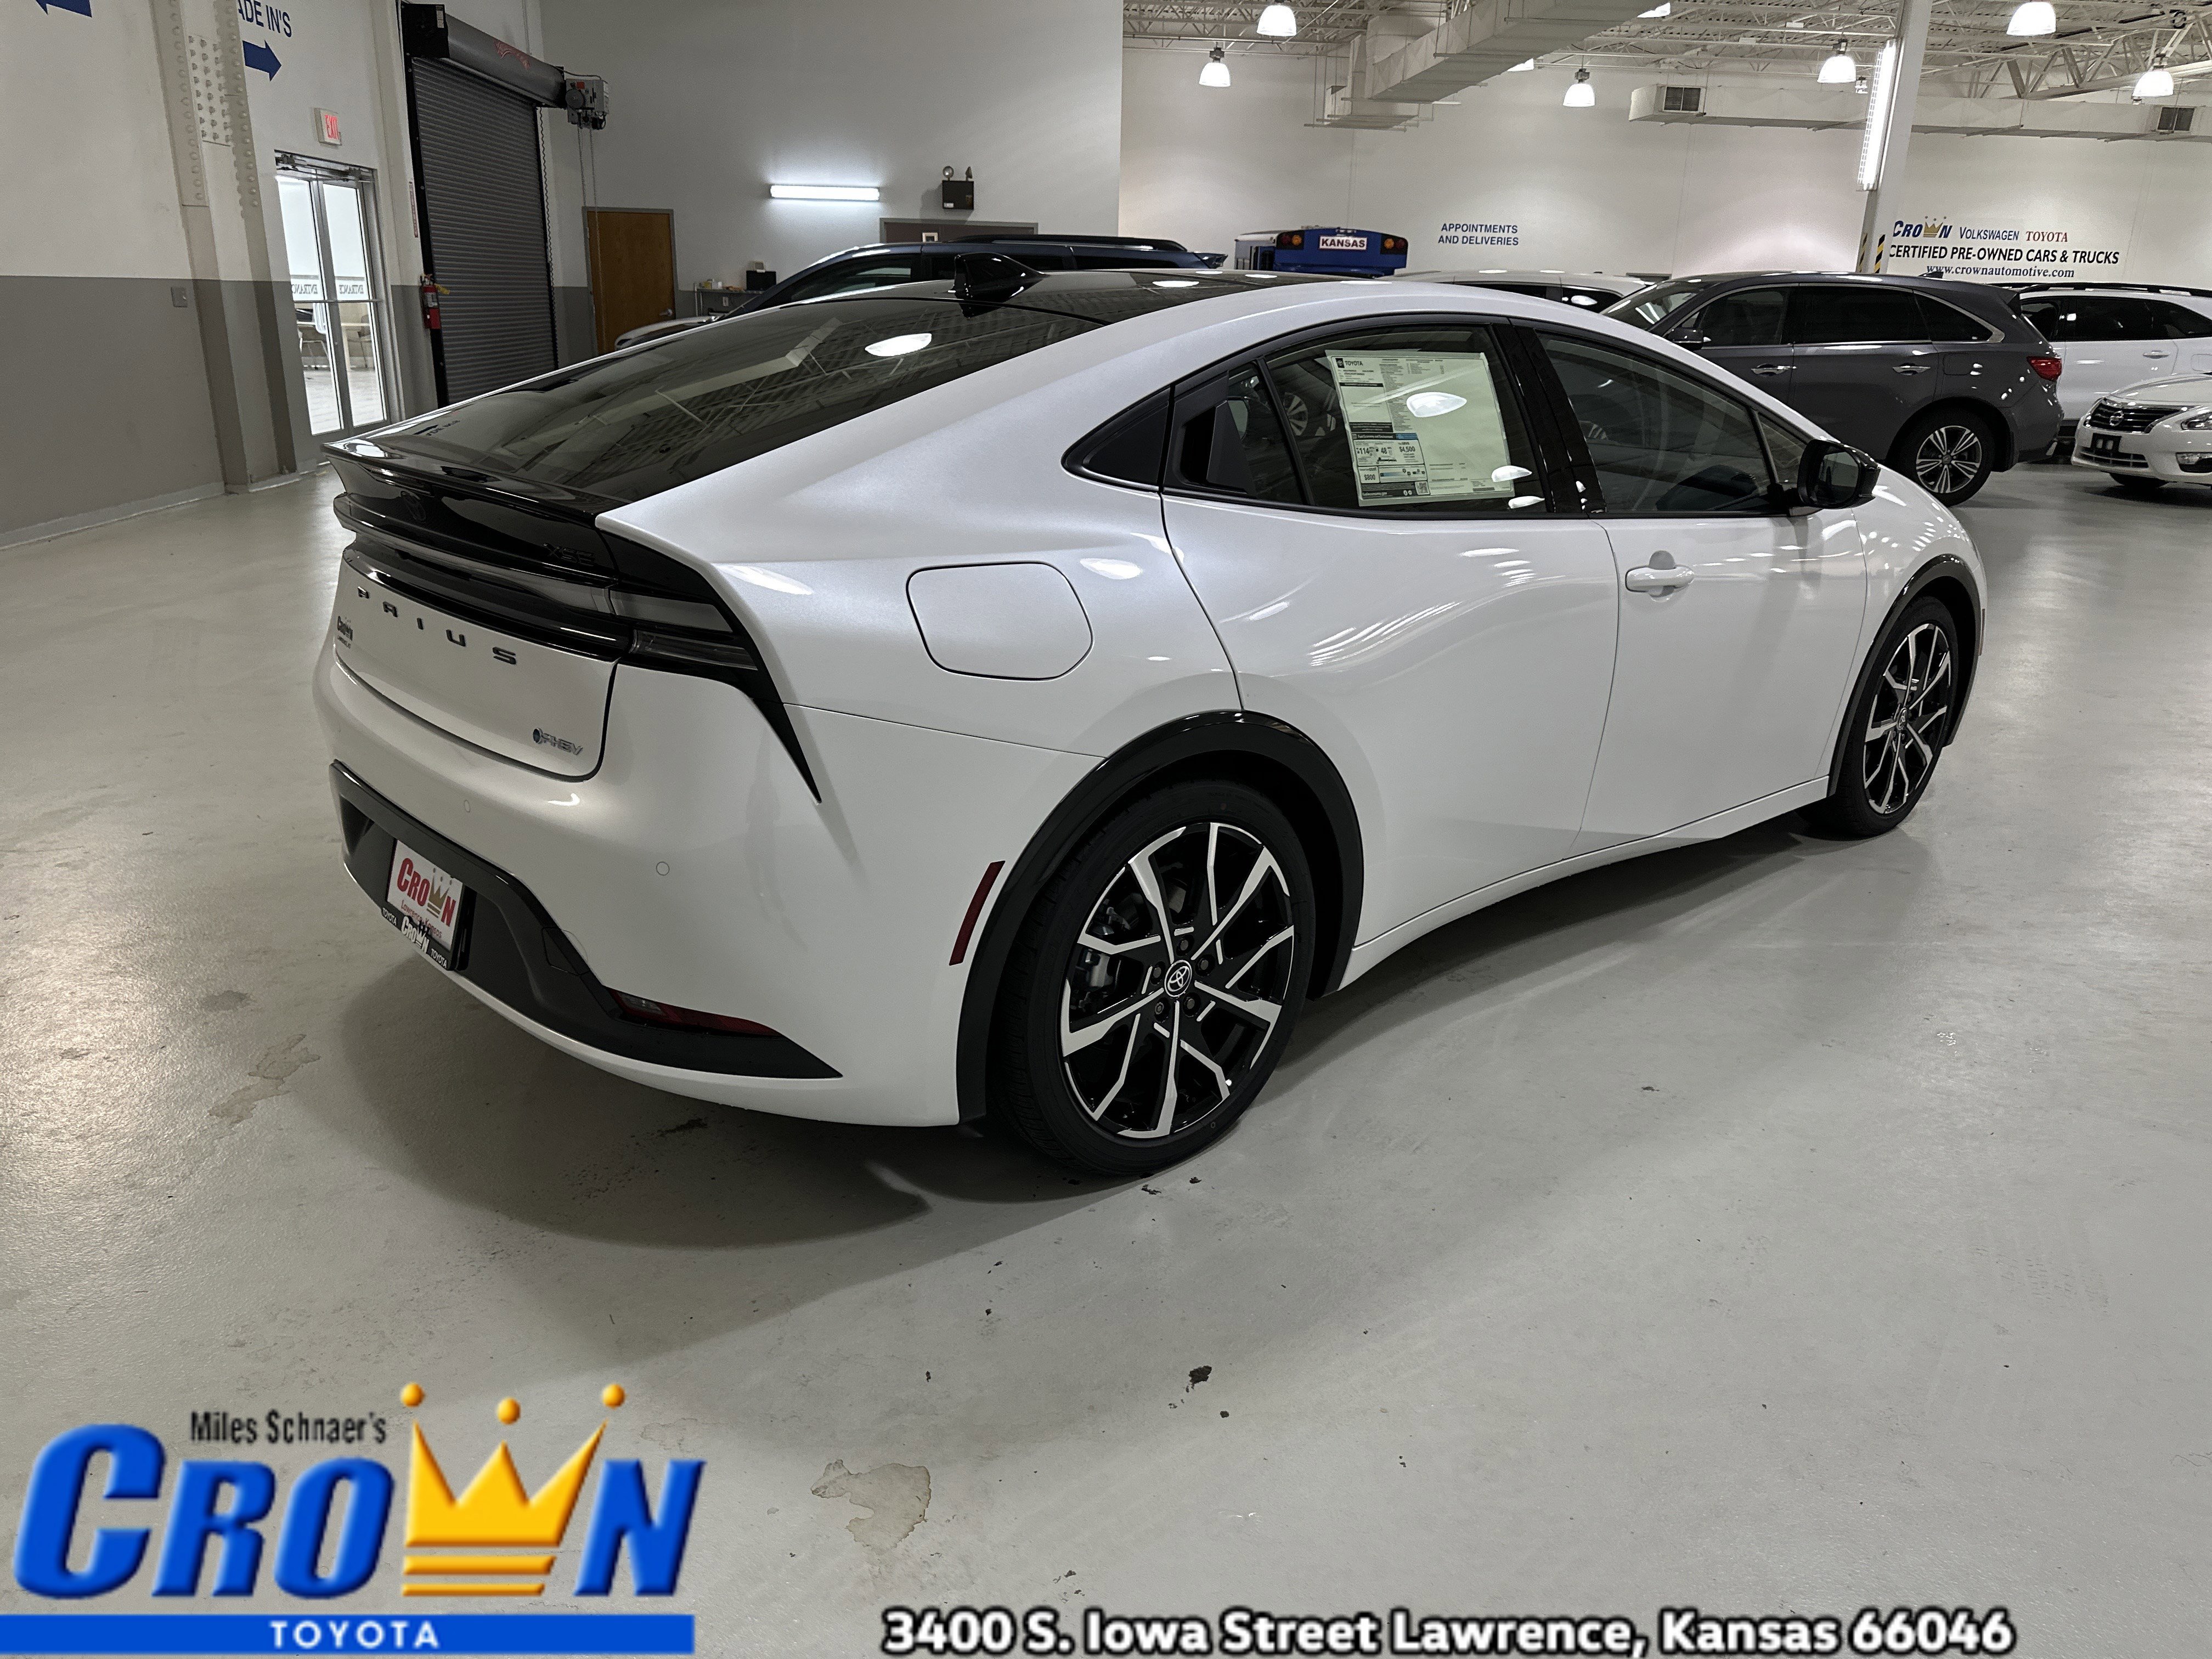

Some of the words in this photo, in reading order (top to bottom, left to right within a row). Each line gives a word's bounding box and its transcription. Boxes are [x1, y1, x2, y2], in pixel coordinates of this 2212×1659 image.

[266, 5, 292, 37] IN'S
[325, 114, 339, 139] EXIT
[1441, 223, 1518, 234] APPOINTMENTS
[2026, 231, 2068, 242] TOYOTA
[1321, 238, 1365, 248] KANSAS
[1438, 235, 1459, 244] AND
[1462, 235, 1519, 246] DELIVERIES
[1889, 245, 1948, 259] CERTIFIED
[1950, 246, 2023, 261] PRE-OWNED
[2026, 249, 2057, 262] CARS
[2059, 250, 2068, 262] &
[2072, 250, 2119, 264] TRUCKS
[1927, 266, 2074, 278] www.crownautomotive.com
[357, 586, 517, 665] PRIUS
[397, 857, 456, 927] CROWN
[382, 907, 397, 927] TOYOTA
[431, 948, 447, 969] TOYOTA
